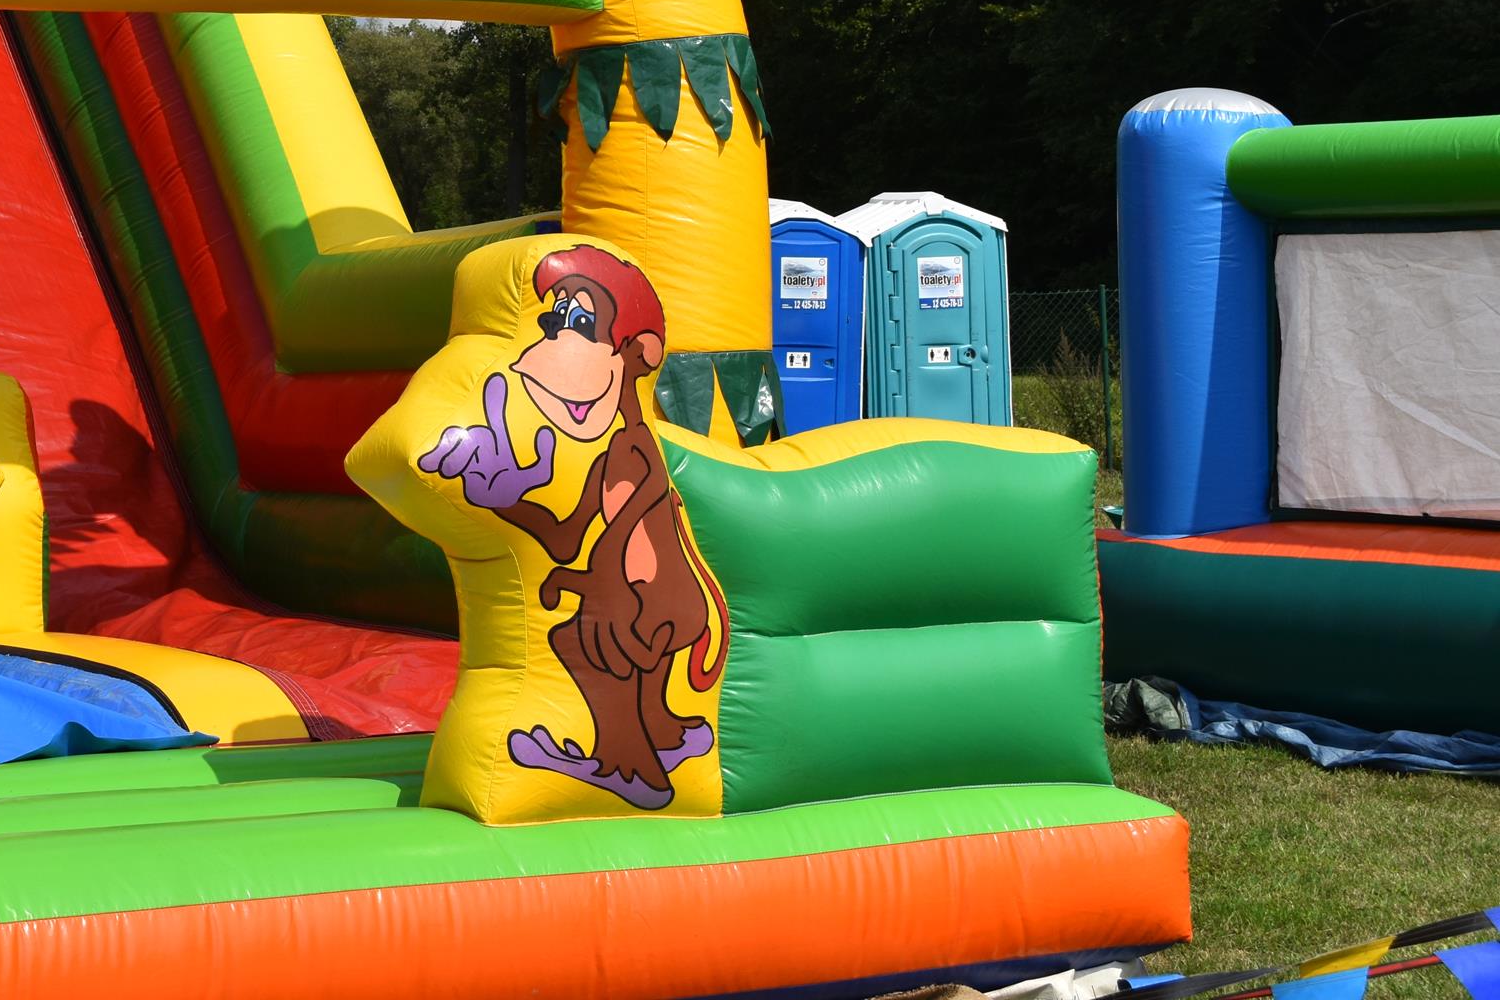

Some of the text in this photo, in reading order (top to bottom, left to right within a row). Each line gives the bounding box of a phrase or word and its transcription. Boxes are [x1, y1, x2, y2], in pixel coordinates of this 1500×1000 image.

[783, 275, 825, 287] toalety.pl
[920, 274, 961, 286] toalety.pl
[794, 300, 801, 309] 12
